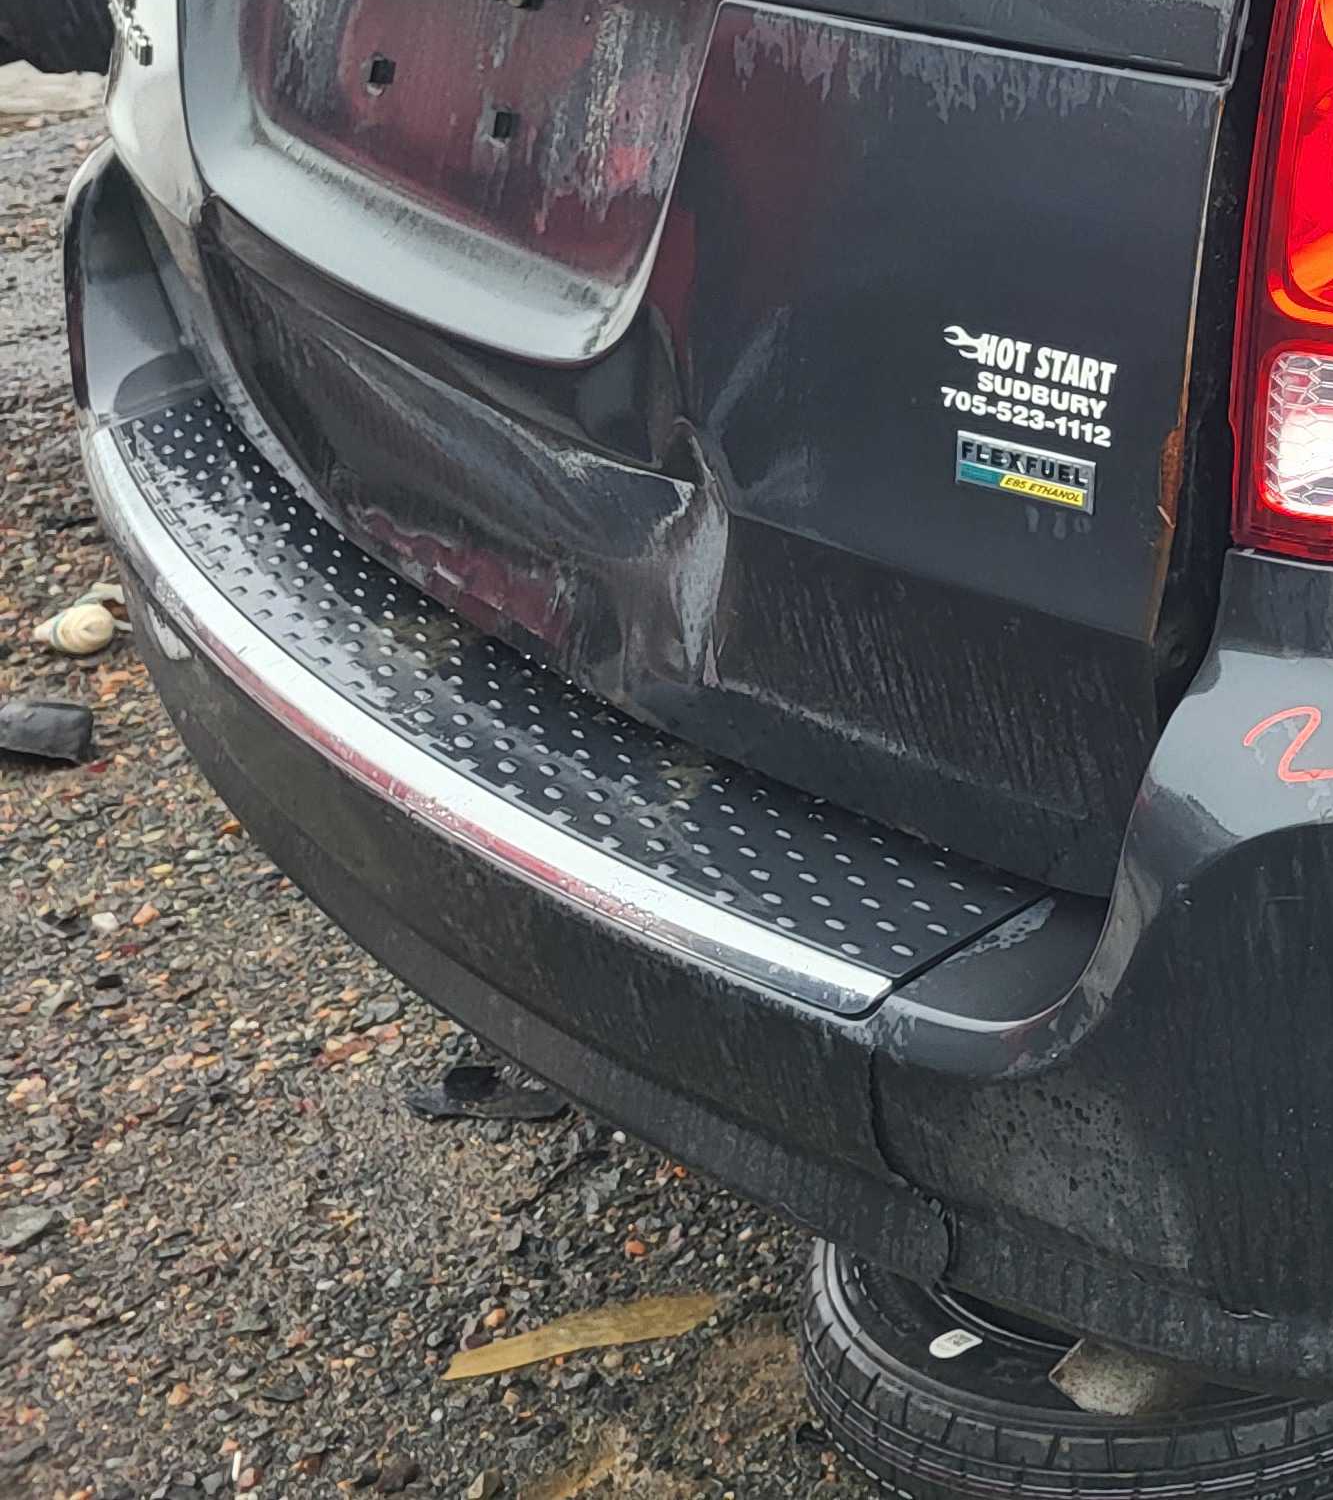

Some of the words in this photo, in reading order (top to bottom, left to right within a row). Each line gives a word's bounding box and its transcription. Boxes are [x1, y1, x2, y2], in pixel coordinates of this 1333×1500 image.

[977, 333, 1032, 374] HOT
[1034, 346, 1118, 395] START
[940, 386, 1112, 448] 705-523-1112
[977, 371, 1107, 420] SUDBURY
[960, 440, 1089, 487] FLEXFUEL
[1004, 477, 1027, 490] E85
[1028, 482, 1081, 503] ETHANOL
